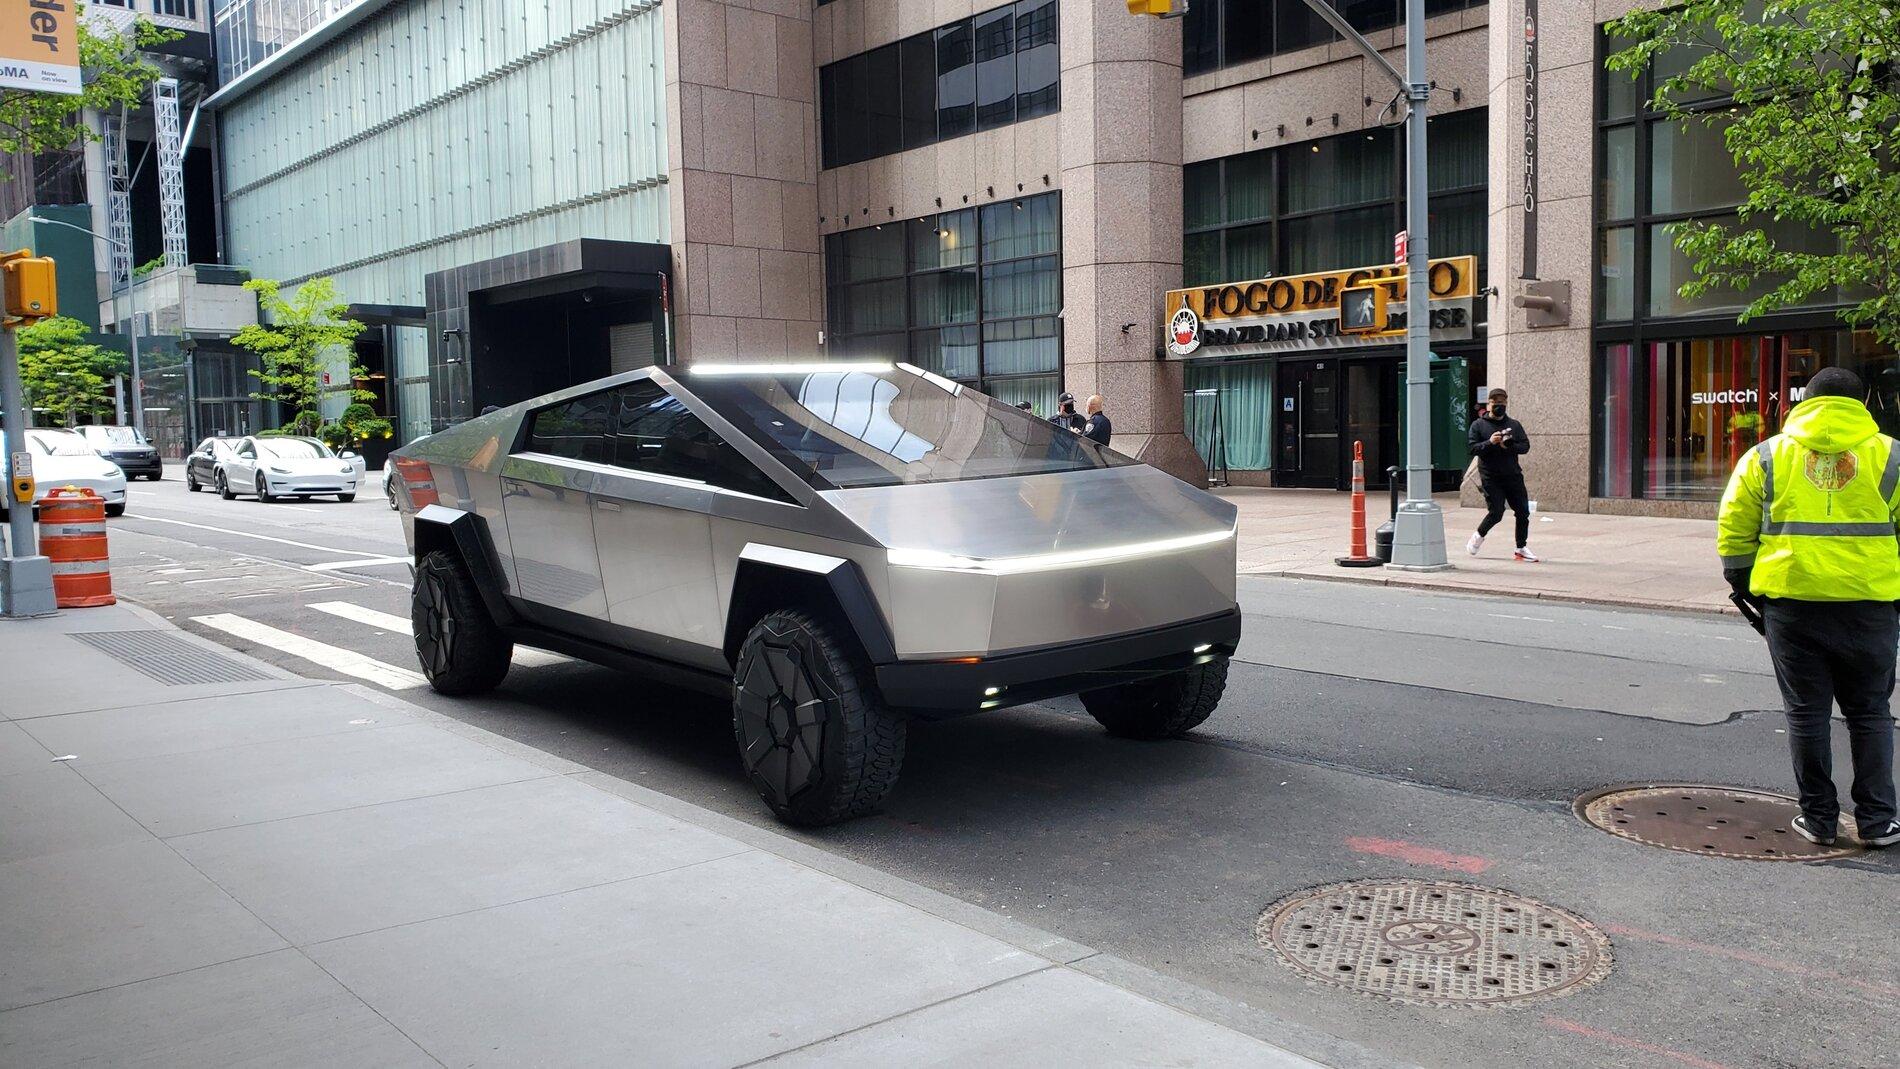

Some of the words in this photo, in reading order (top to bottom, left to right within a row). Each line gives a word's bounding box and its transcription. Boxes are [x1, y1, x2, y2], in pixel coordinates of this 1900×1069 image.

[1525, 45, 1535, 121] FOGO
[1202, 279, 1295, 318] FOGO
[1302, 277, 1338, 305] DE
[1692, 388, 1758, 404] swatch
